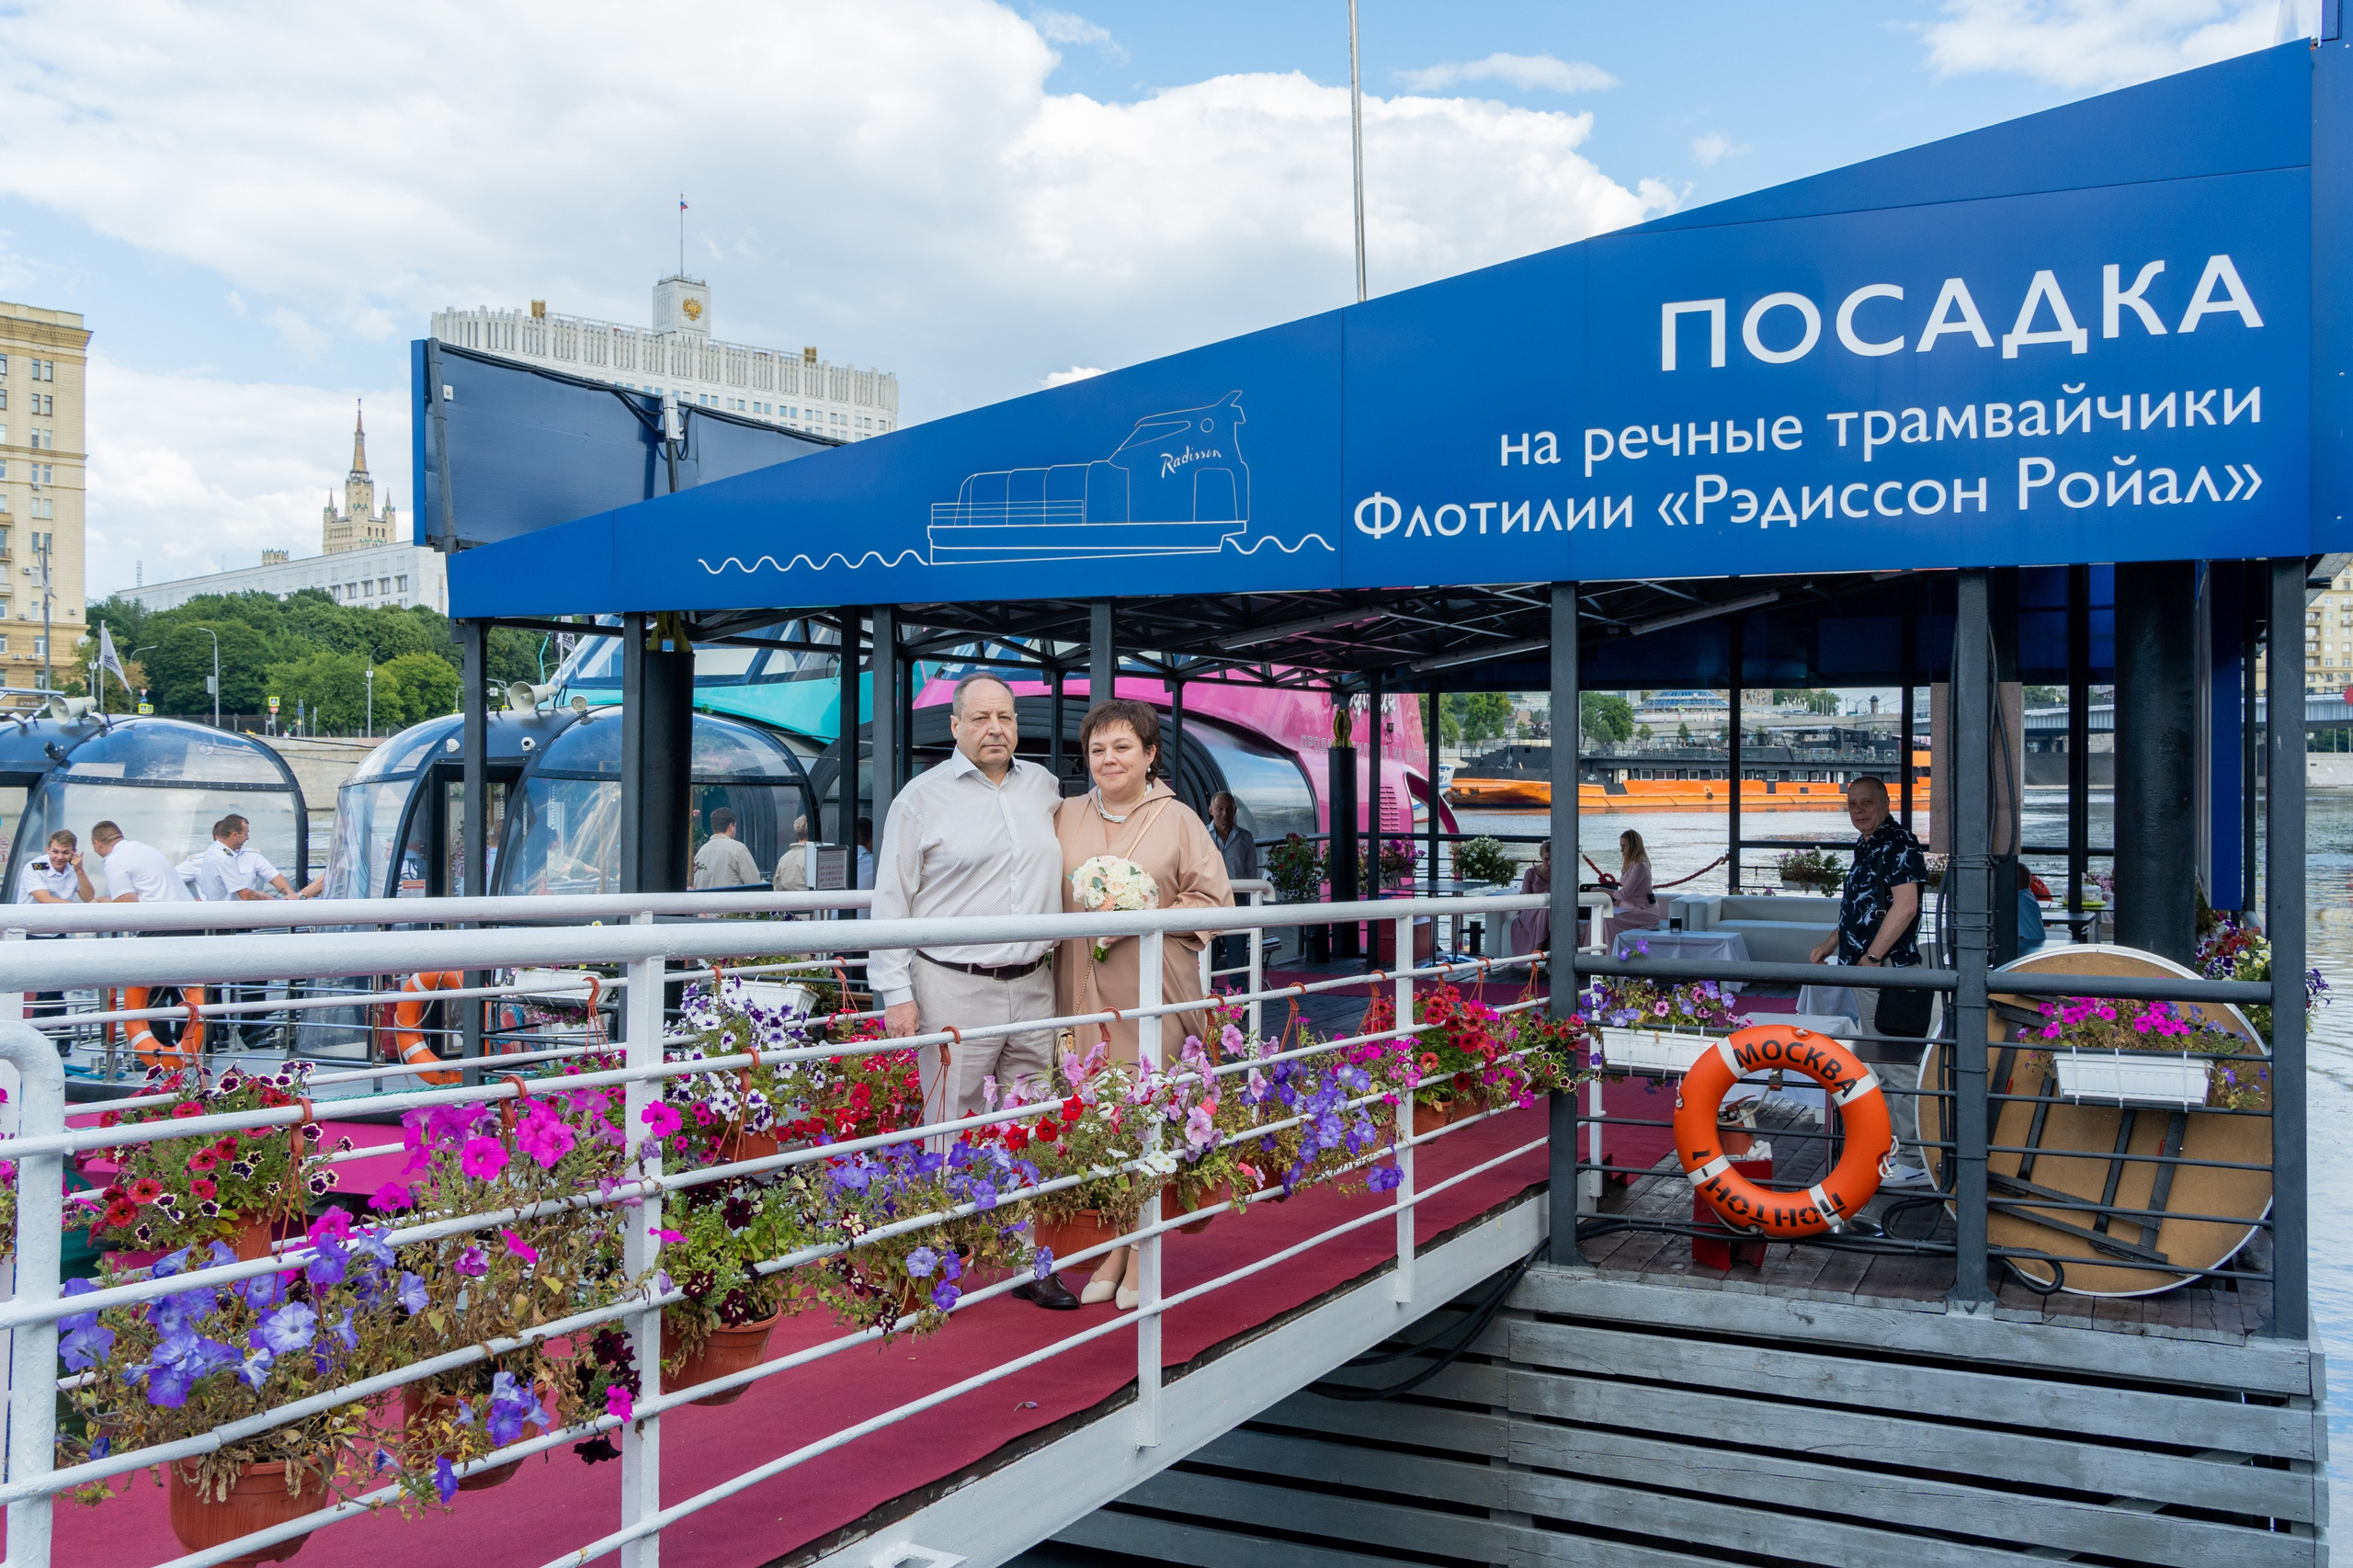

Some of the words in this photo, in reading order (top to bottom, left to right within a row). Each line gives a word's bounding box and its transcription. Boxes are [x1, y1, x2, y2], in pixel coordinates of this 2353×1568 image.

[1661, 253, 2266, 372] ПОСАДКА
[1159, 445, 1223, 480] Radisson
[1500, 430, 1563, 467] на
[1584, 415, 1804, 479] речные
[1825, 381, 2263, 463] трамвайчики
[1353, 490, 1634, 540] Флотилии
[1656, 473, 1989, 534] «Рэдиссон
[2017, 453, 2264, 511] Ройал»
[1733, 1039, 1859, 1099] МОСКВА
[1690, 1149, 1847, 1228] ПОНТОН-1
